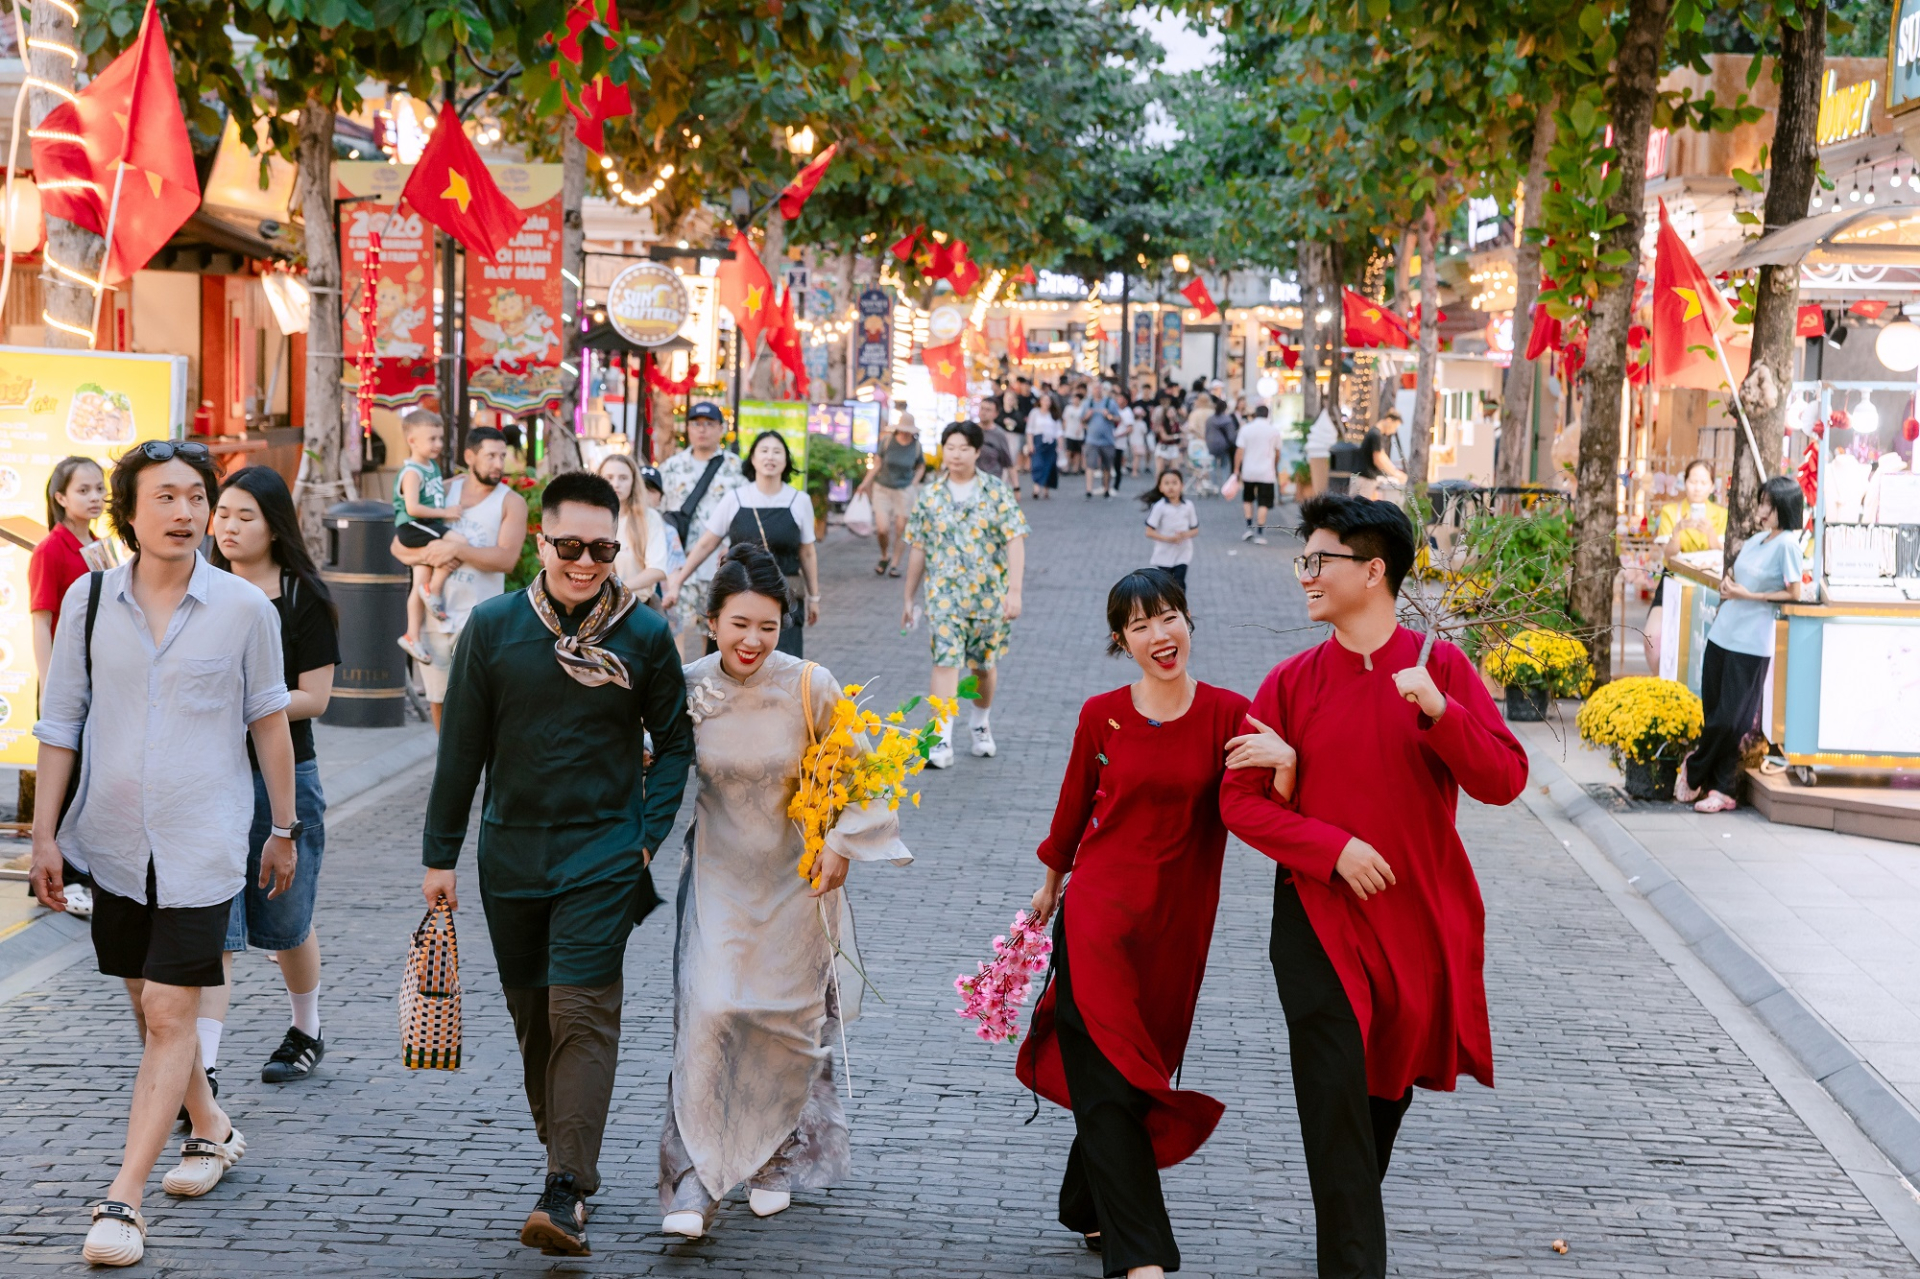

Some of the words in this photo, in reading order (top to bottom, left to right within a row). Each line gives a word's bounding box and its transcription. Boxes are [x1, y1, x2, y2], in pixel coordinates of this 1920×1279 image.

[1897, 9, 1920, 67] SU
[348, 210, 424, 239] 2026
[342, 667, 389, 681] LITTER
